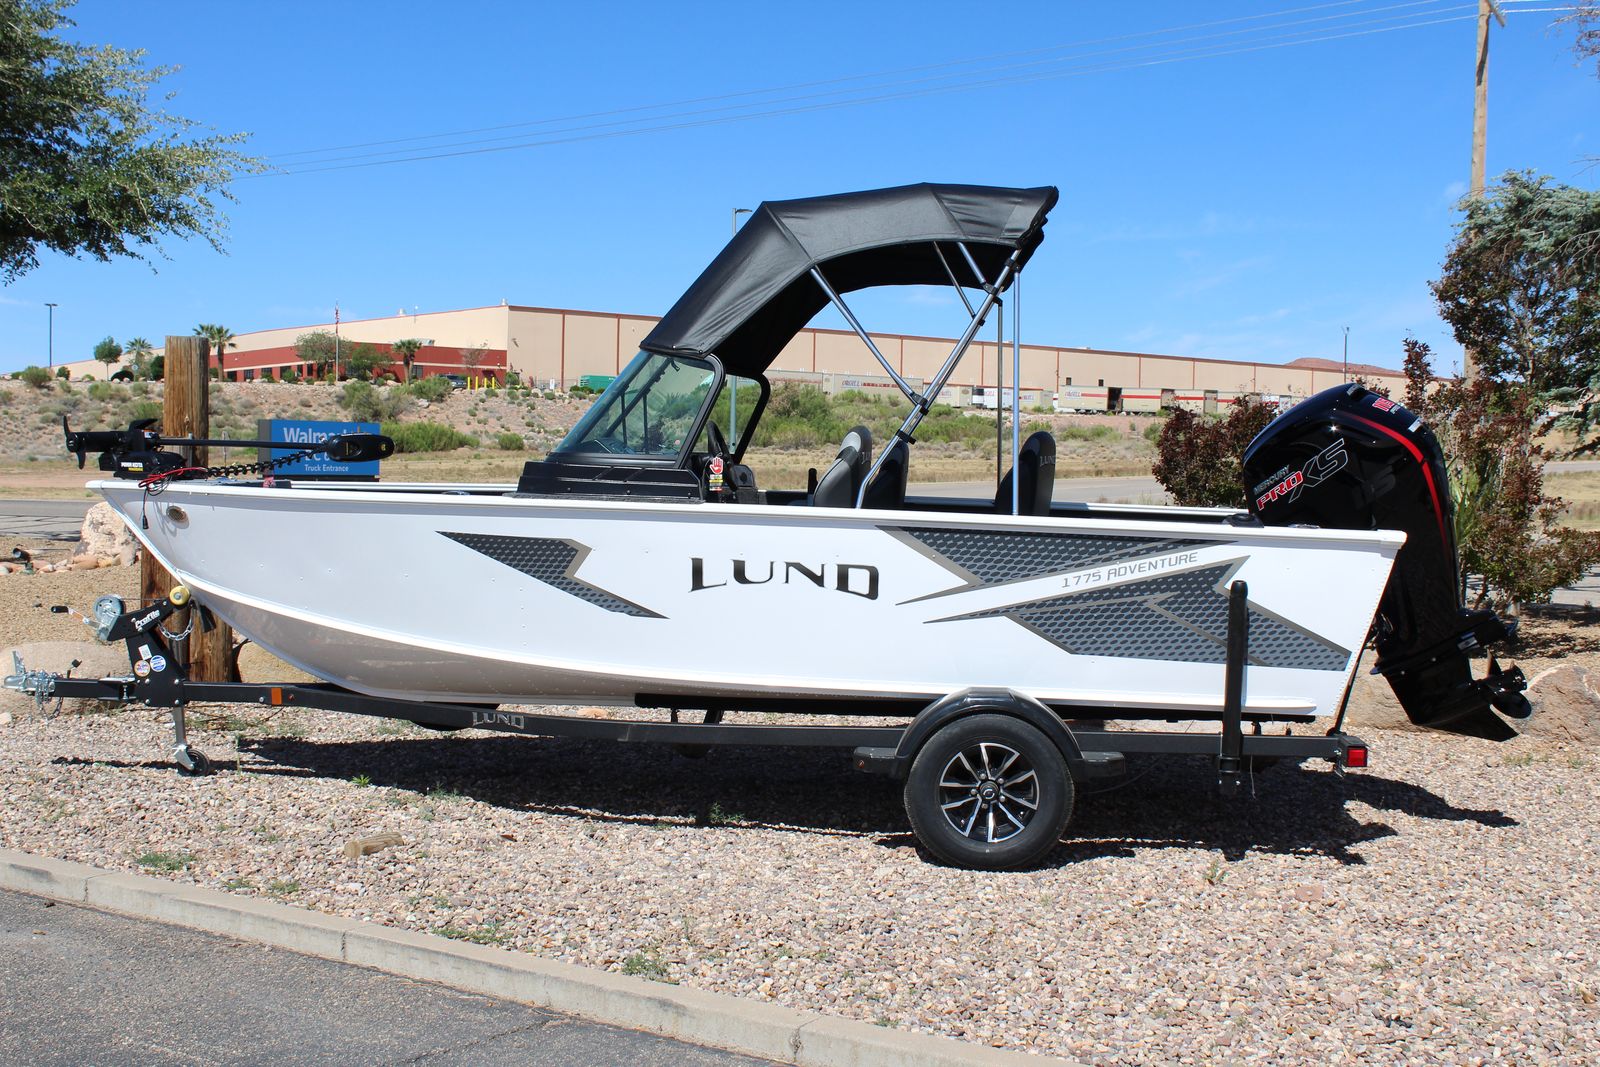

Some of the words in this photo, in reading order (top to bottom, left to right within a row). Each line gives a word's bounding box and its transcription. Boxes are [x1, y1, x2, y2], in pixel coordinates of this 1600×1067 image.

[283, 427, 346, 443] Walm
[1253, 464, 1290, 495] MERCURY
[1256, 470, 1303, 511] PRO
[688, 557, 879, 600] LUND
[1062, 571, 1102, 588] 1775
[1107, 552, 1198, 581] ADVENTURE
[472, 711, 525, 730] LUND
